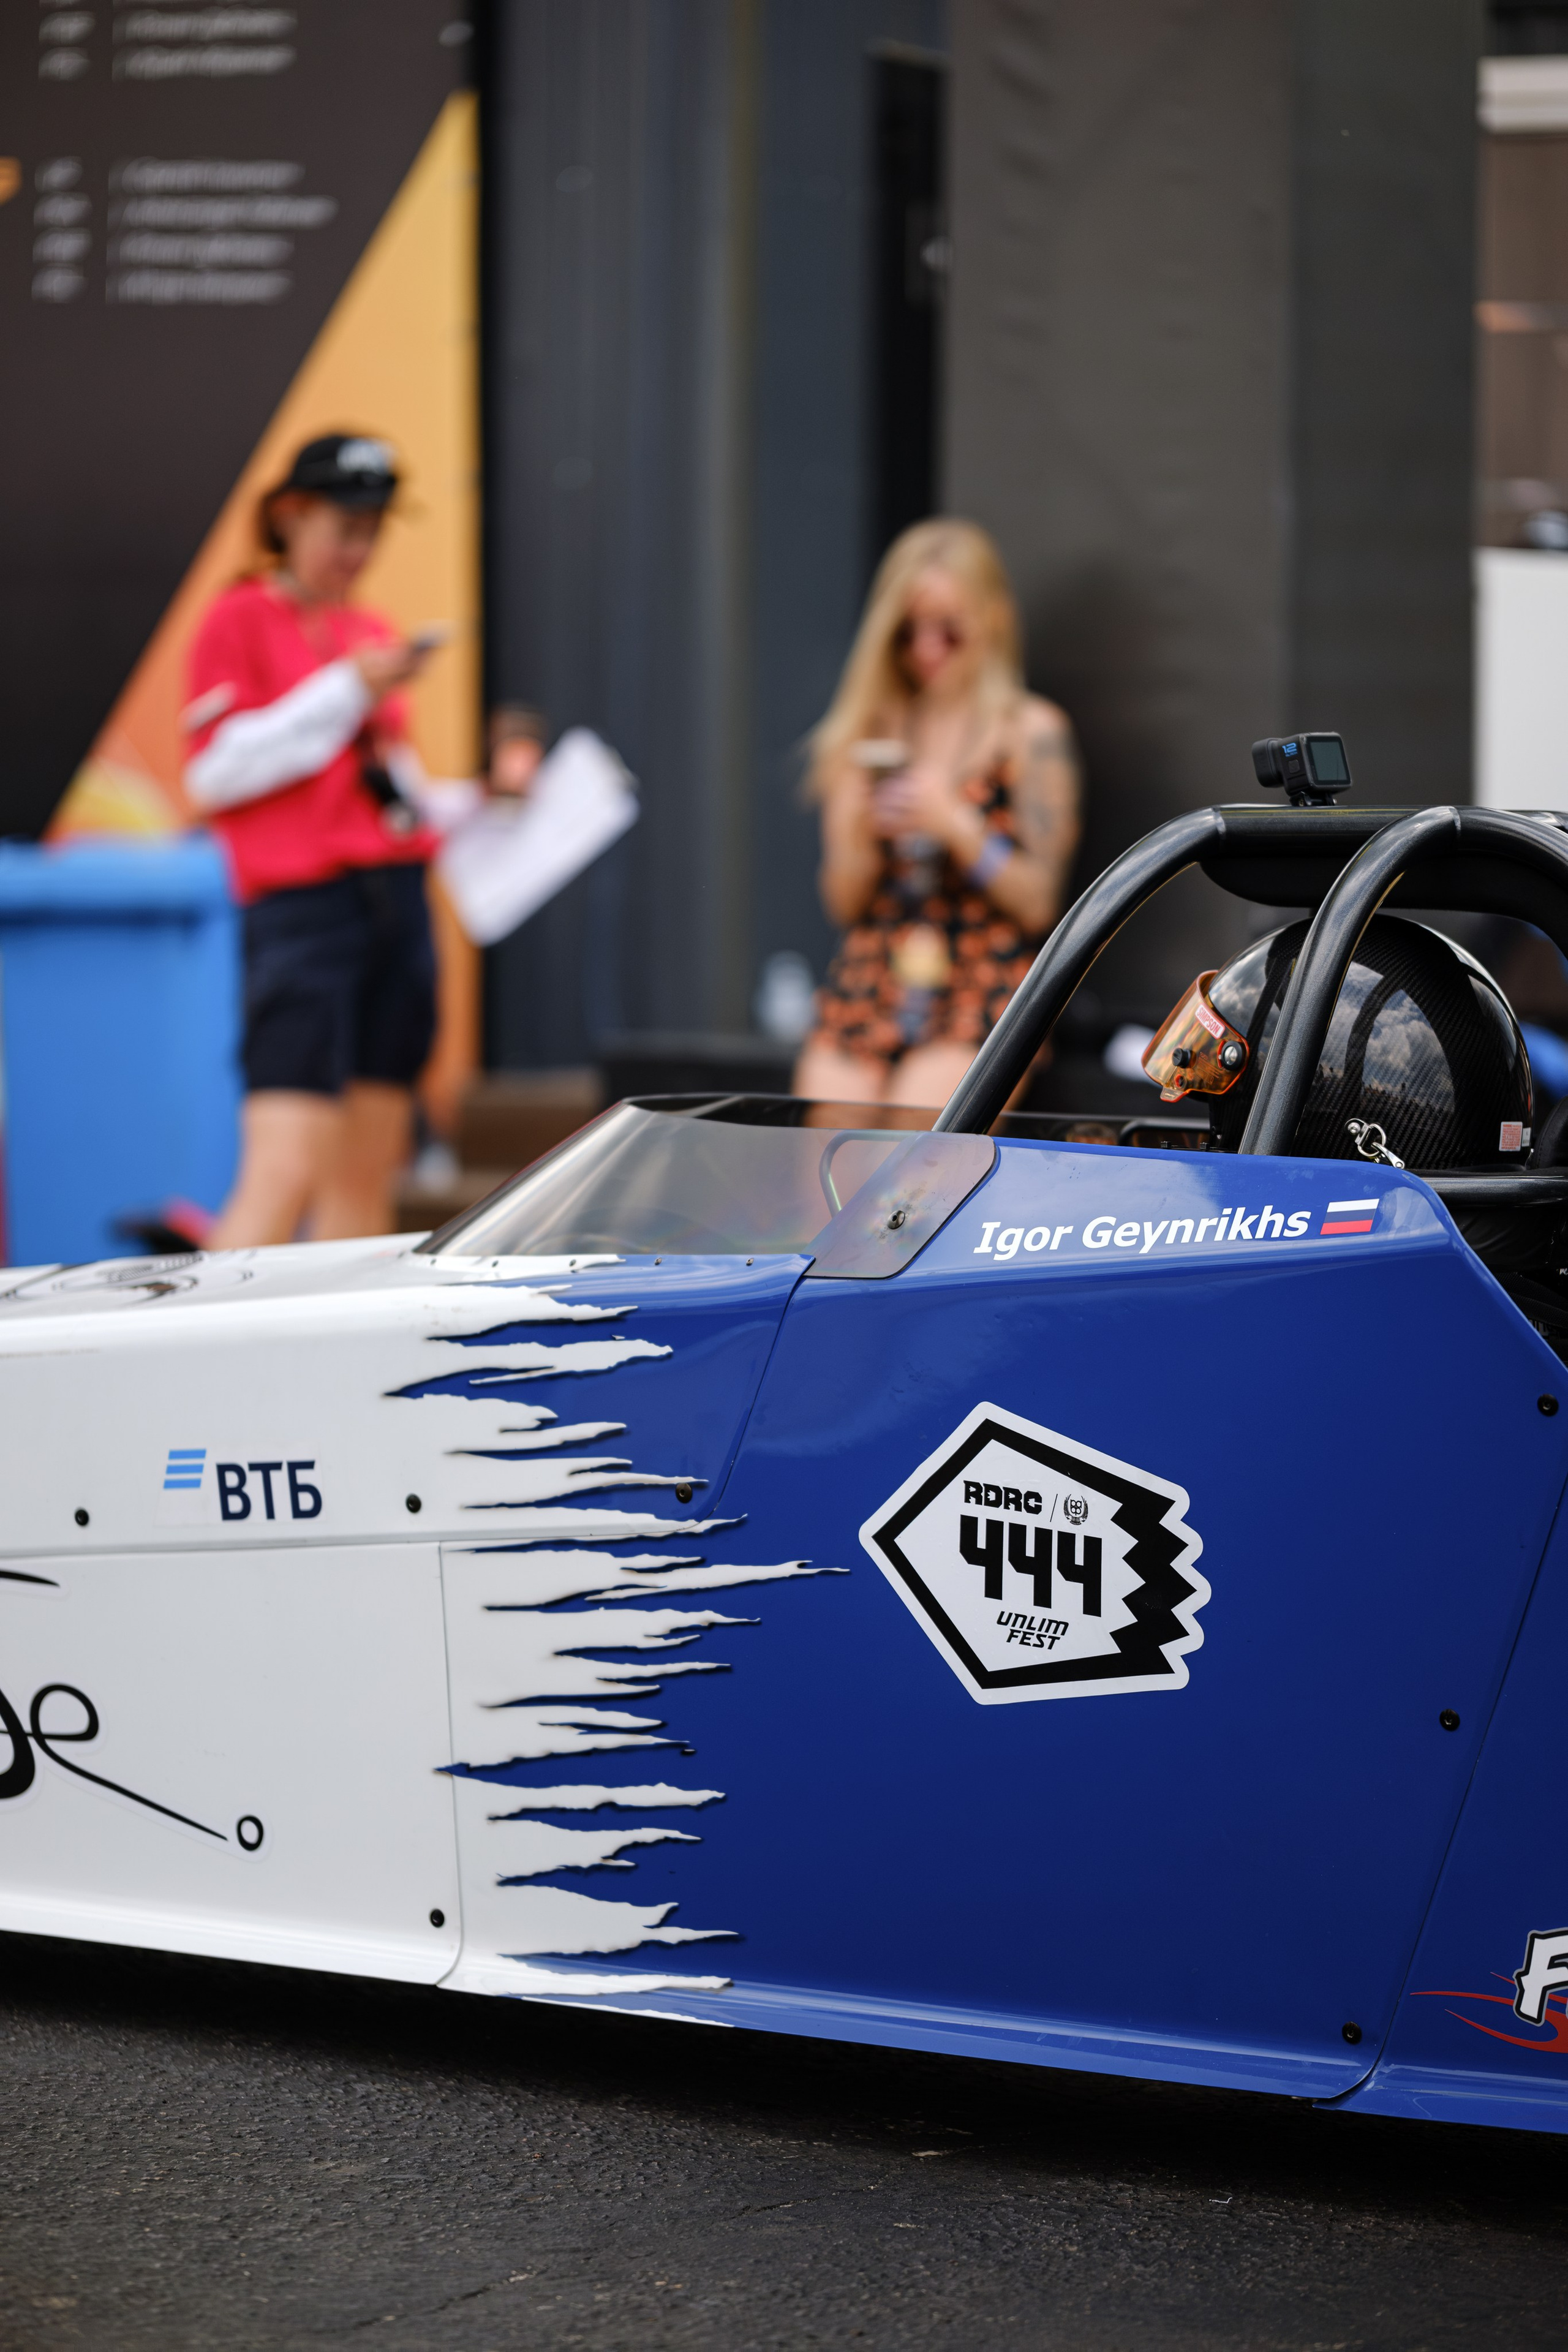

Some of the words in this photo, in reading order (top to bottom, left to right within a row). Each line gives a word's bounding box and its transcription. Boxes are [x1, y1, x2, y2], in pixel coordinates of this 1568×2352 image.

[1282, 742, 1297, 754] 12
[1196, 1006, 1221, 1035] SIMPSON
[973, 1221, 1074, 1261] Igor
[1082, 1205, 1311, 1254] Geynrikhs
[216, 1460, 323, 1521] ВТБ
[963, 1480, 1042, 1515] RDRC
[959, 1514, 1102, 1618] 444
[997, 1611, 1069, 1636] UNLIM
[1006, 1628, 1061, 1650] FEST
